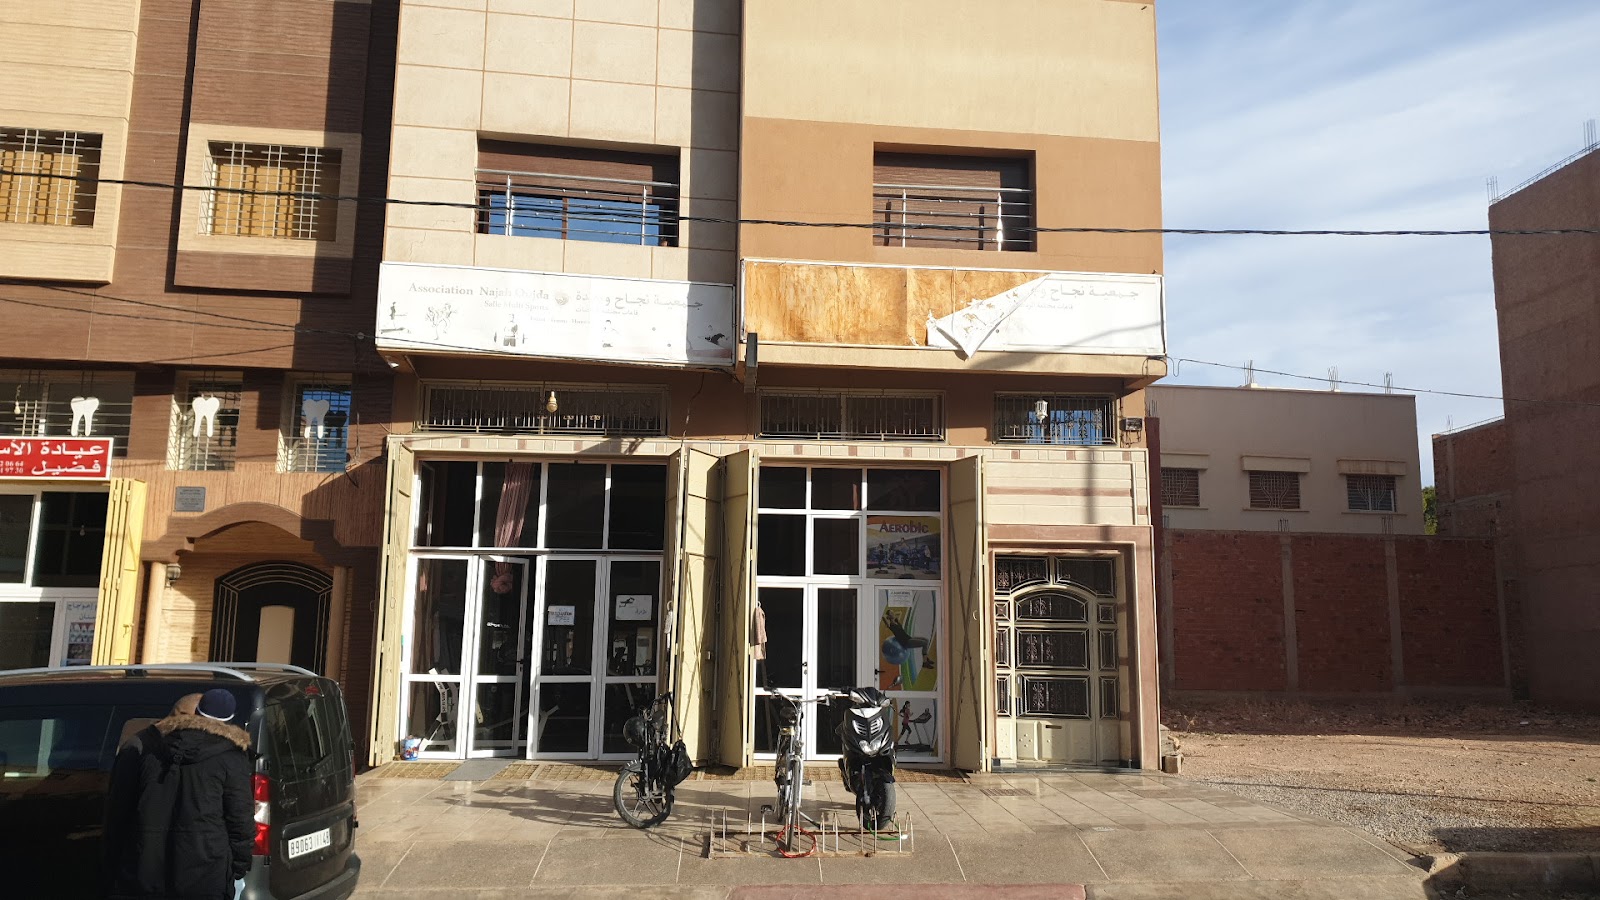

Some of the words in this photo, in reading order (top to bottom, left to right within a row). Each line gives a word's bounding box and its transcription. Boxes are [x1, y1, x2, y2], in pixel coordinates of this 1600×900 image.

[408, 282, 474, 296] Association
[479, 286, 512, 299] Najah
[1050, 283, 1085, 302] نجاح
[1089, 286, 1138, 301] جمعية
[615, 293, 650, 310] نجاح
[40, 441, 105, 459] عيادة
[31, 459, 101, 475] فضيل
[290, 837, 312, 855] 89063
